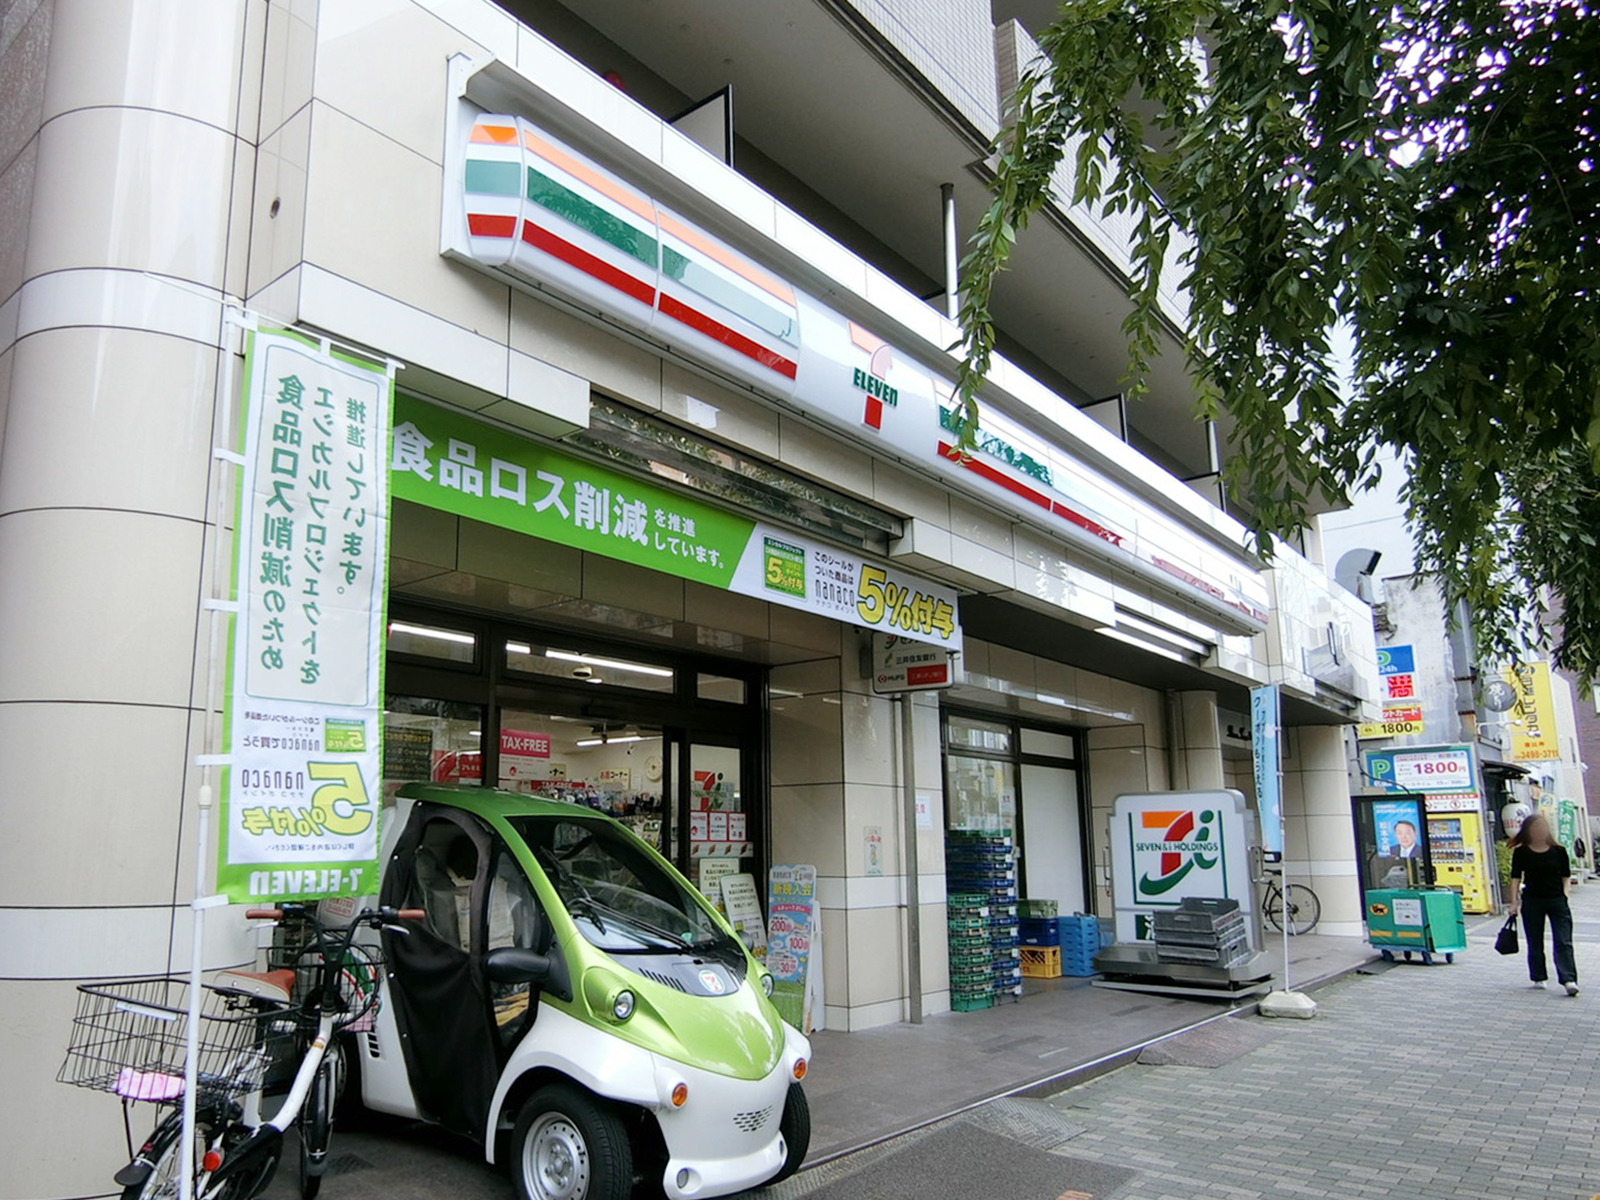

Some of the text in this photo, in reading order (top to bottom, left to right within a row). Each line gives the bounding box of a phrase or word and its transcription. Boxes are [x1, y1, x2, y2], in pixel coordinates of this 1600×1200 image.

[390, 422, 648, 548] 食品ロス削減
[654, 508, 696, 538] を推進
[654, 531, 725, 569] しています。
[814, 551, 855, 572] このシールが
[814, 565, 854, 585] ついた商品は
[814, 579, 855, 607] nanaco
[856, 563, 955, 640] 5%付与
[1387, 675, 1414, 698] 満
[502, 735, 548, 752] TAX-FREE
[1173, 842, 1219, 851] HOLDINGS
